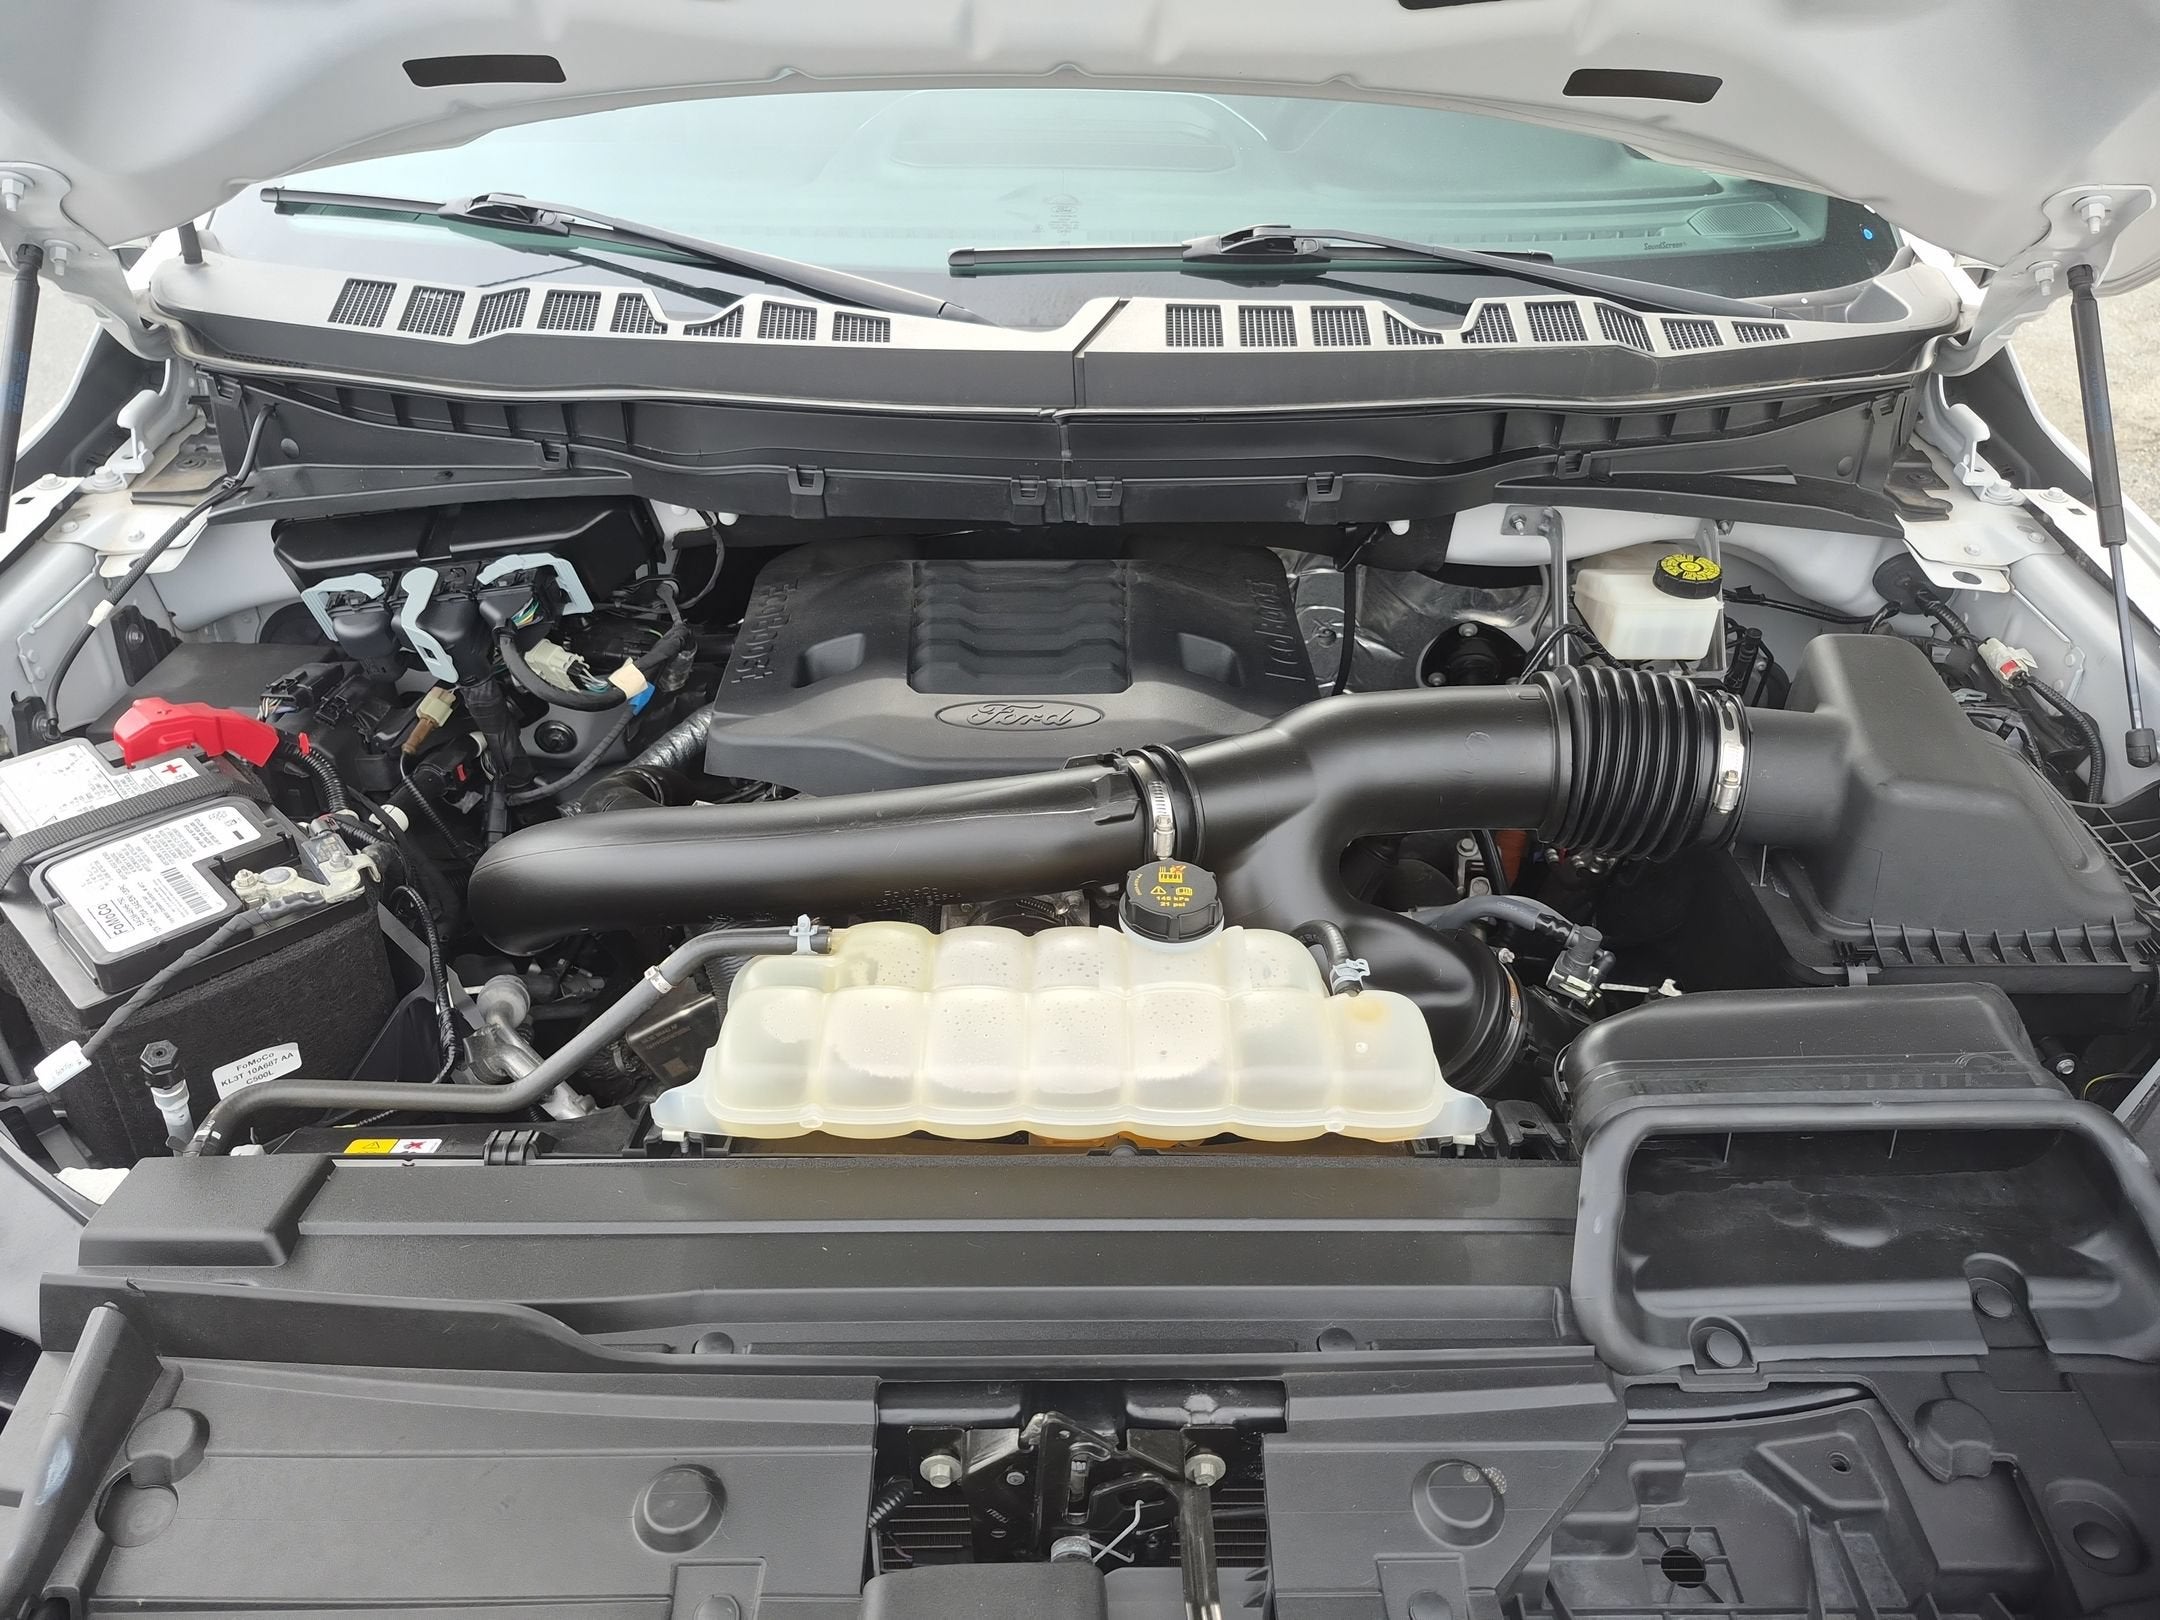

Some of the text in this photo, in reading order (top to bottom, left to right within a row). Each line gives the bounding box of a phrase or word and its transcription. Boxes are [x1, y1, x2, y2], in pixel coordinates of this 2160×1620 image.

[967, 704, 1075, 726] Ford
[98, 903, 129, 936] FoMoCo
[220, 1073, 245, 1087] KL3T
[281, 1052, 294, 1062] AA
[236, 1052, 275, 1072] FoMoCo
